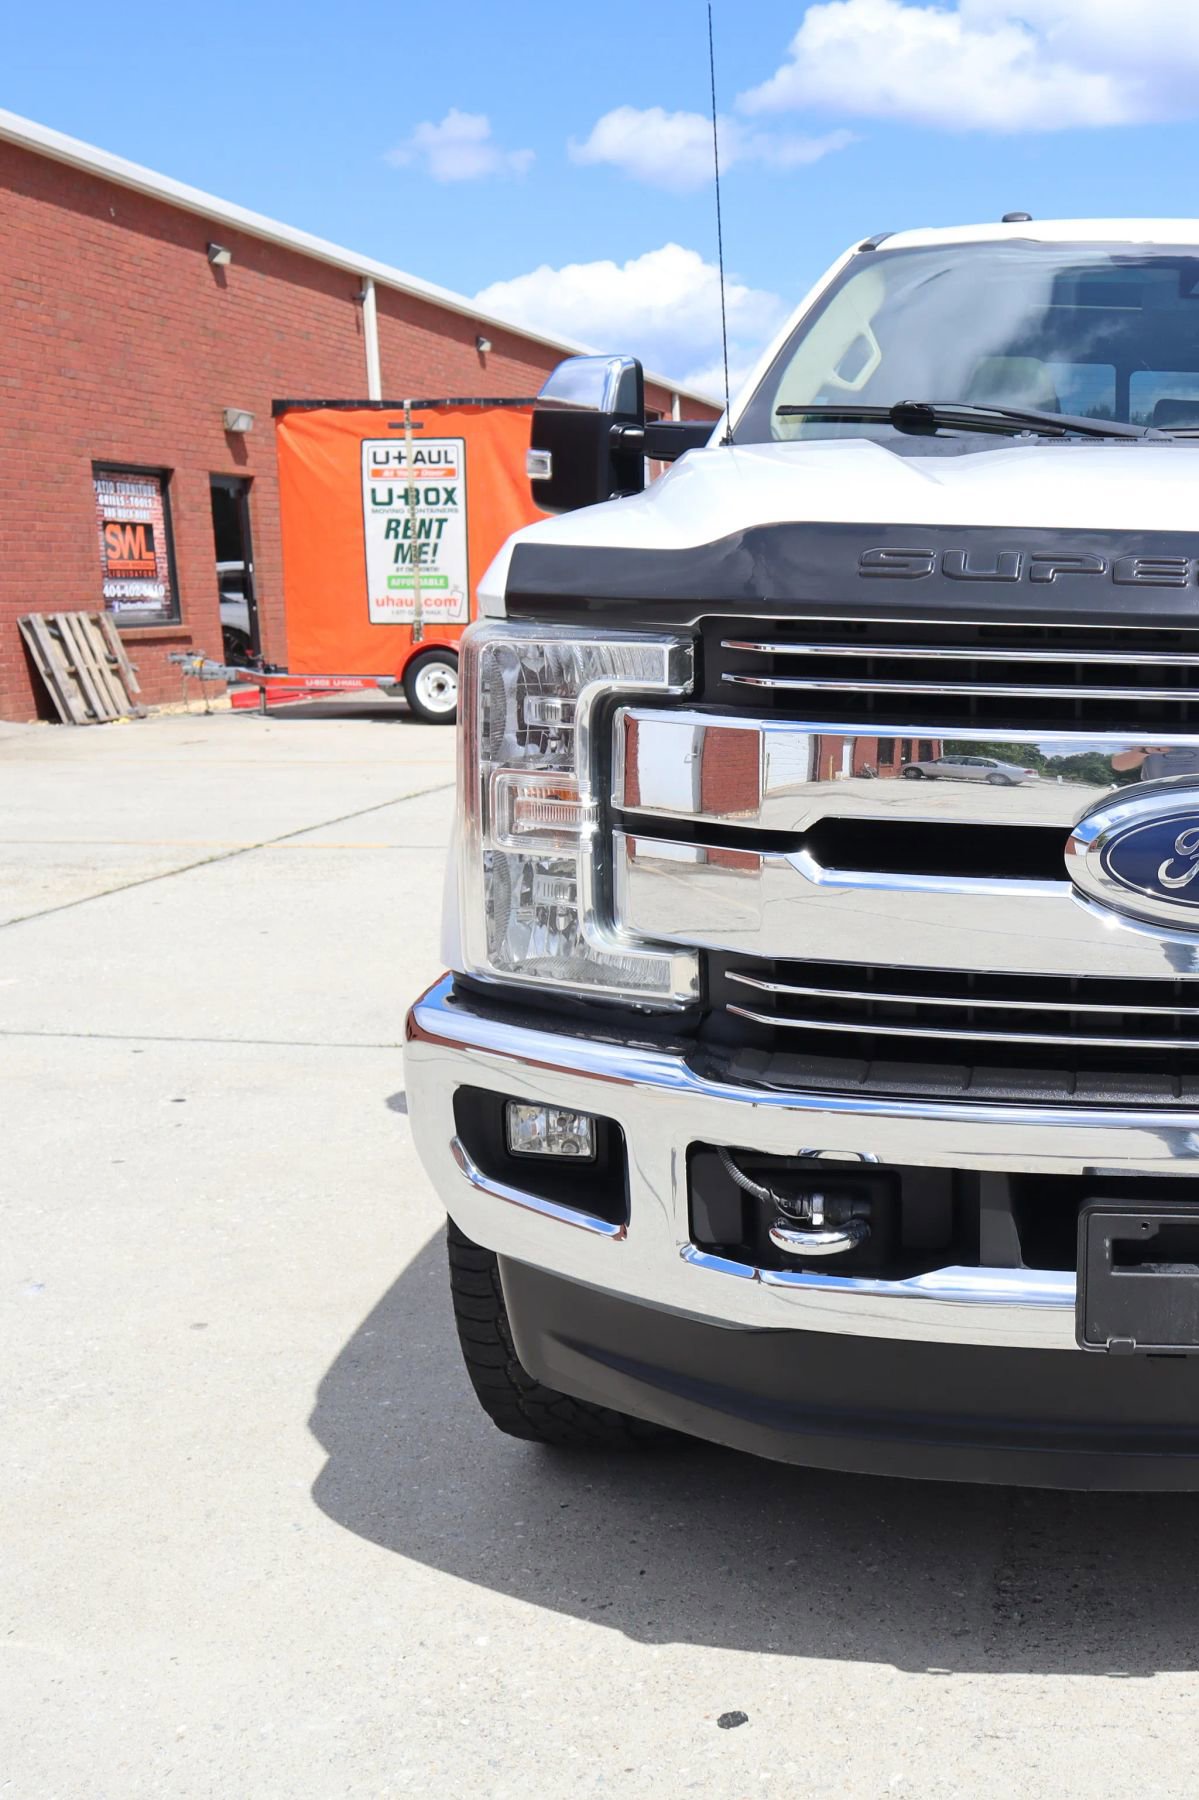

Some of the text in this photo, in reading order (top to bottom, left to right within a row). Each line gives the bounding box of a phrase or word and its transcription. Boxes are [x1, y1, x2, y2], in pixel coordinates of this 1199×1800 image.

[384, 518, 448, 540] RENT
[105, 524, 155, 560] SWL
[393, 542, 439, 564] ME!
[390, 577, 445, 587] AFFODABLE
